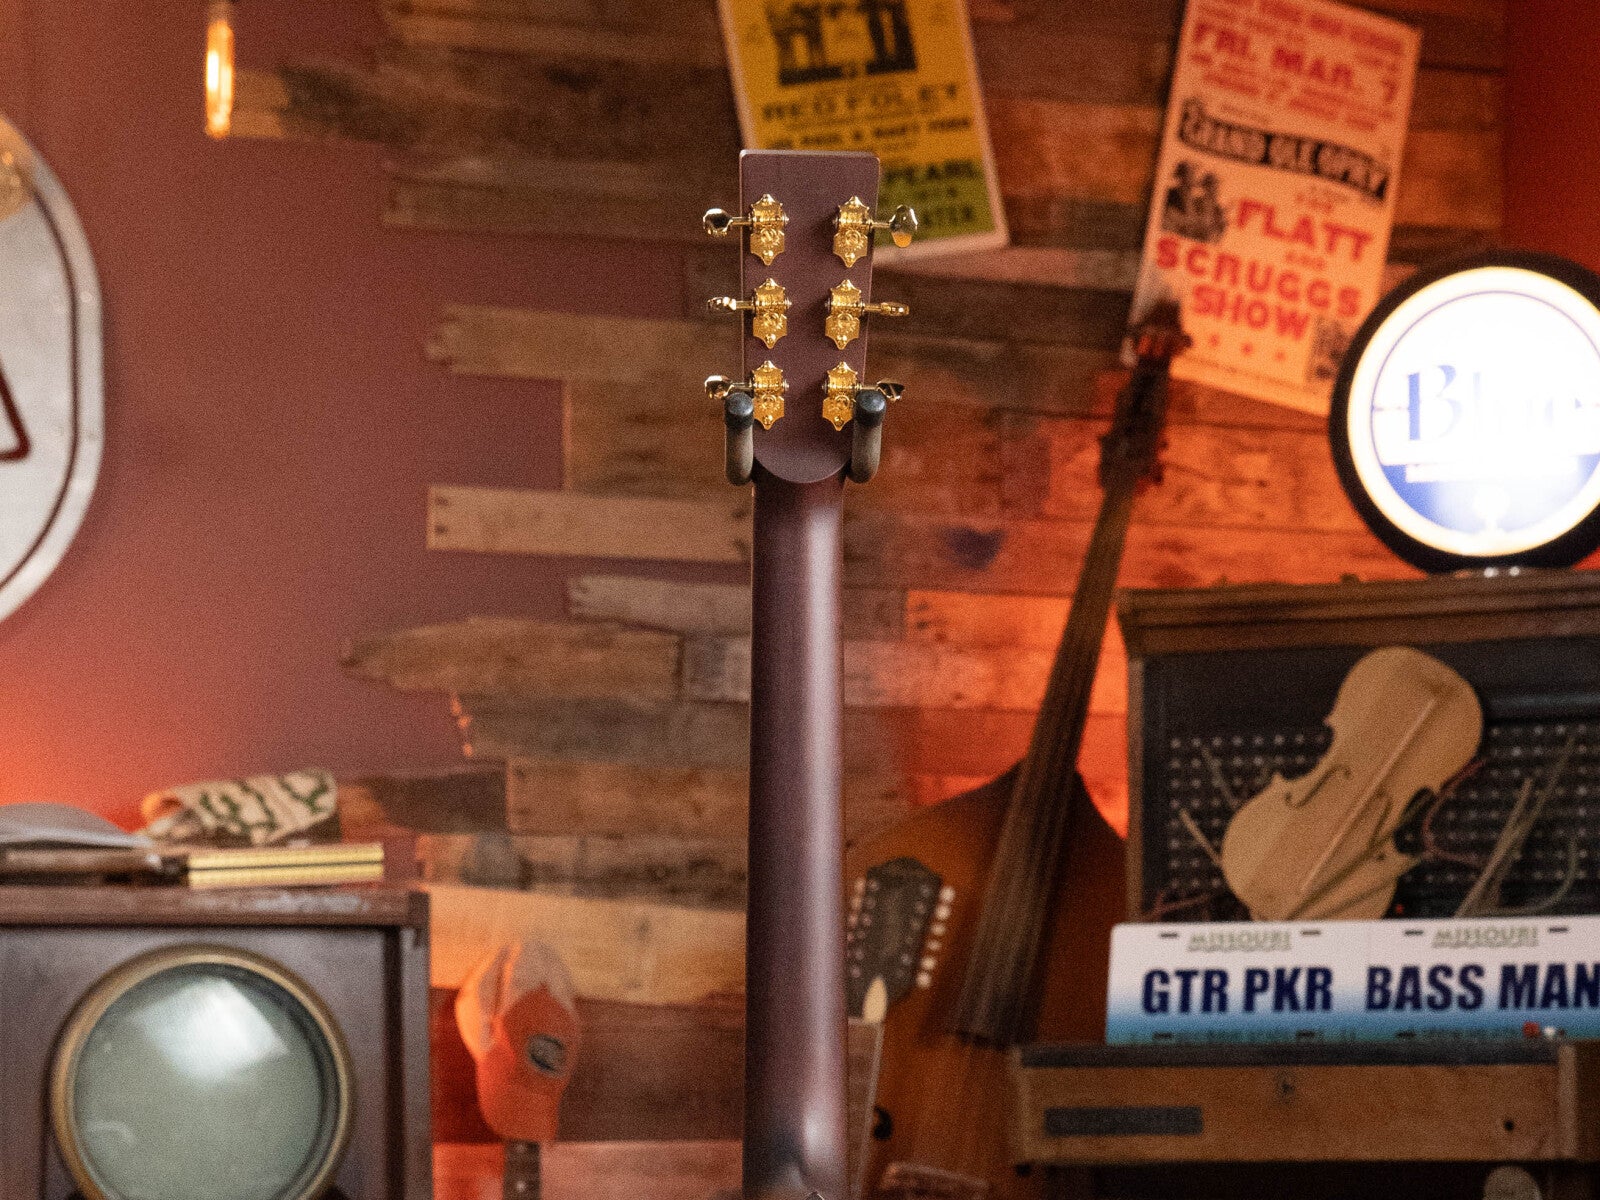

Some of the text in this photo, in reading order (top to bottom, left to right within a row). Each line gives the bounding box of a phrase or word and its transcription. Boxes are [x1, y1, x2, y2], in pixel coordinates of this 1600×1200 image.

[1236, 197, 1374, 262] FLATT
[1155, 236, 1362, 318] SCRUGGS
[1191, 284, 1311, 341] SHOW
[1187, 930, 1293, 952] MISSOURI
[1431, 926, 1540, 949] MISSOURI
[1141, 966, 1334, 1015] GTR PKR
[1364, 961, 1600, 1012] BASS MAN
